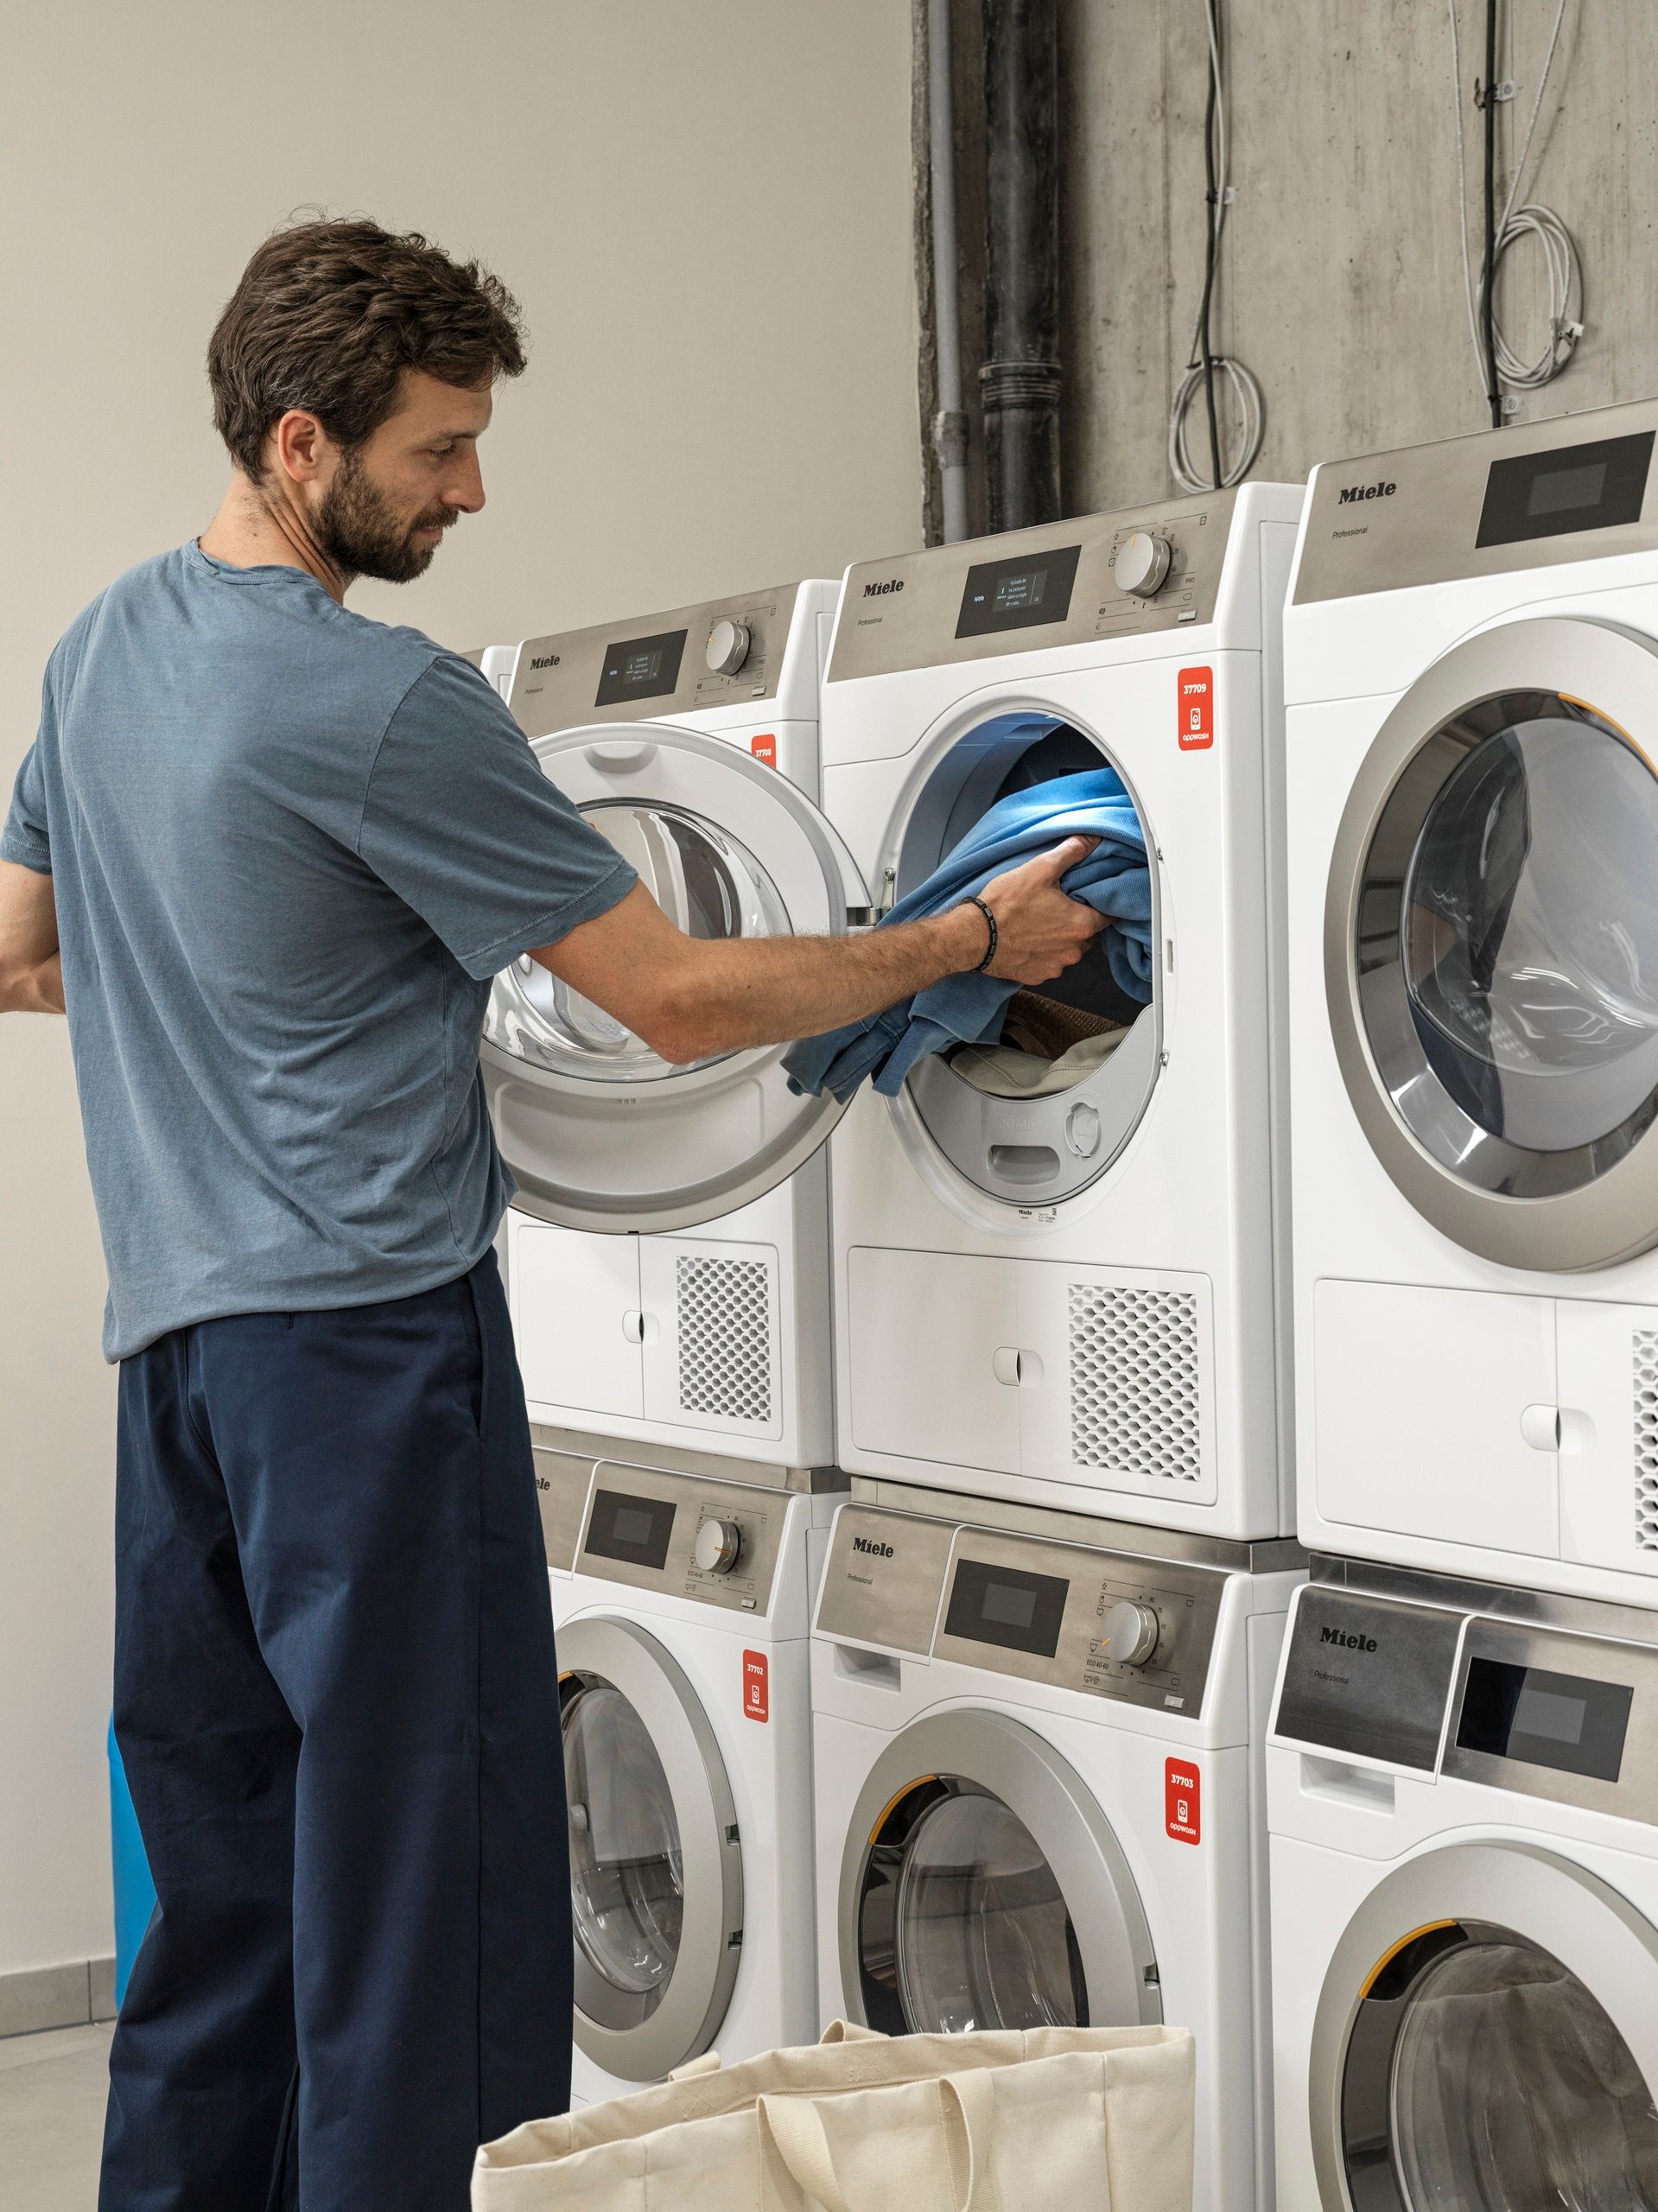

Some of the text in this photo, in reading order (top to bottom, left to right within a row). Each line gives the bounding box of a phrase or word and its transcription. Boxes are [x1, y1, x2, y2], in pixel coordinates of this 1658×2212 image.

[1338, 482, 1396, 505] Miele
[1332, 526, 1369, 539] Professional
[863, 580, 904, 597] Miele
[530, 655, 560, 670] Miele
[1184, 683, 1207, 695] 37709
[755, 748, 772, 758] 37708
[536, 1478, 550, 1491] ele
[853, 1537, 894, 1558] Miele
[1320, 1627, 1377, 1652] Miele
[746, 1663, 764, 1675] 37702
[1314, 1670, 1350, 1684] Professional
[1172, 1774, 1194, 1789] 37703
